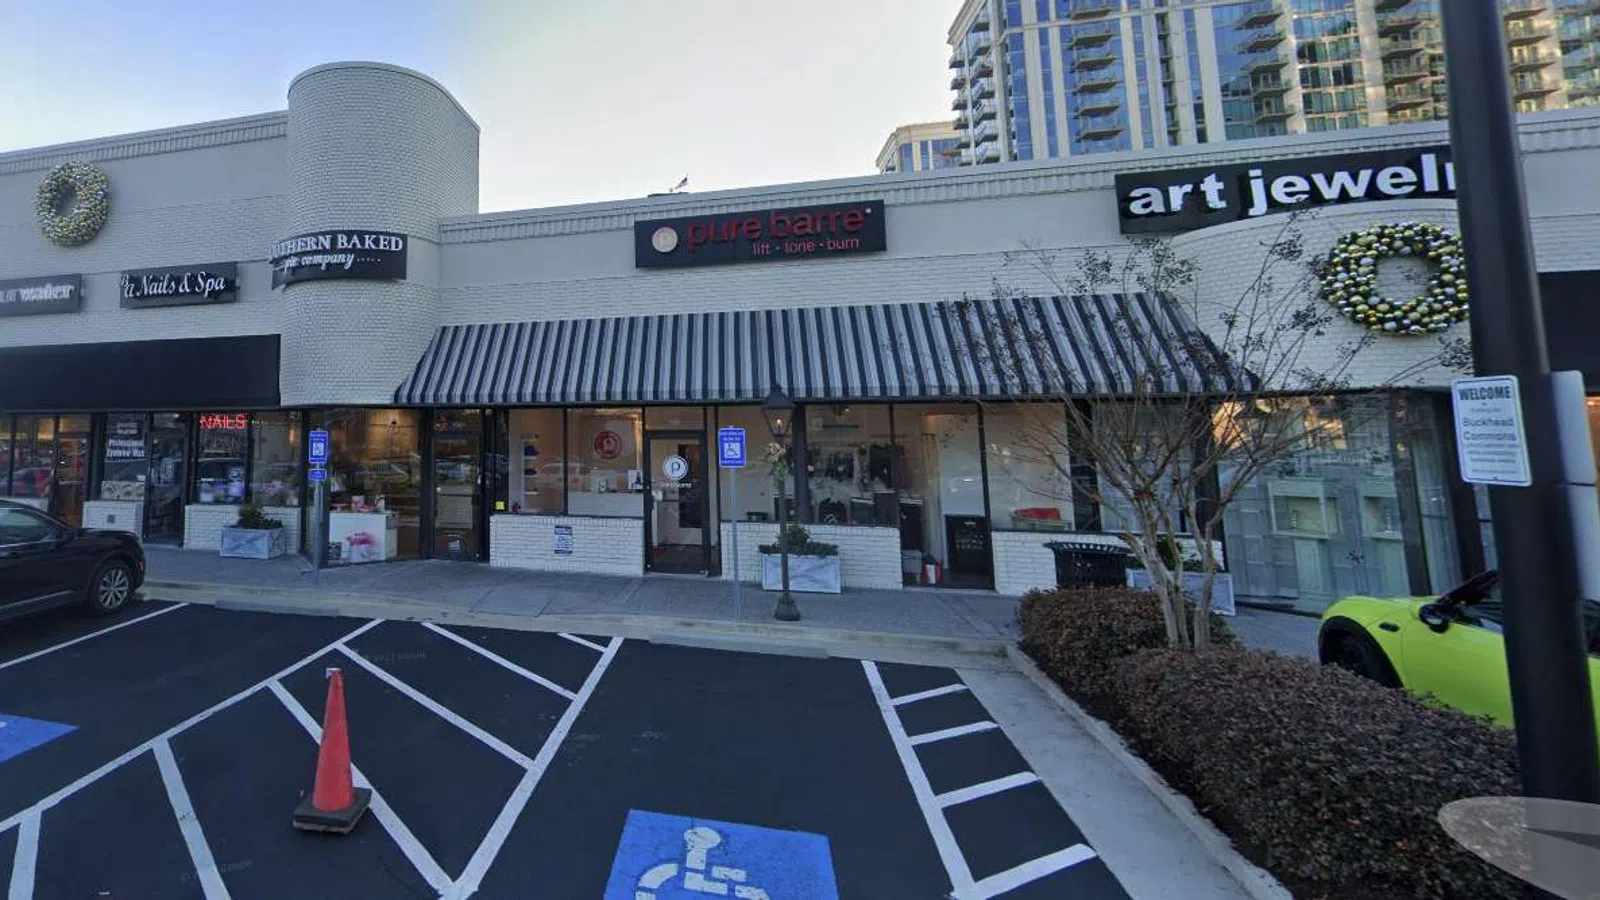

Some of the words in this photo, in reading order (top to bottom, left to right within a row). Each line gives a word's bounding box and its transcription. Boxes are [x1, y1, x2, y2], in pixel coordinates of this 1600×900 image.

[1128, 173, 1227, 215] art
[687, 215, 761, 253] pure
[770, 206, 866, 238] barre
[336, 233, 403, 252] BAKED
[752, 243, 771, 256] lift
[301, 253, 354, 271] company
[136, 272, 176, 297] Nails
[195, 271, 226, 299] Spa
[1459, 386, 1511, 400] WELCOME
[199, 413, 248, 430] NAILS
[1463, 418, 1514, 427] Buckhead
[1464, 431, 1517, 440] Commons
